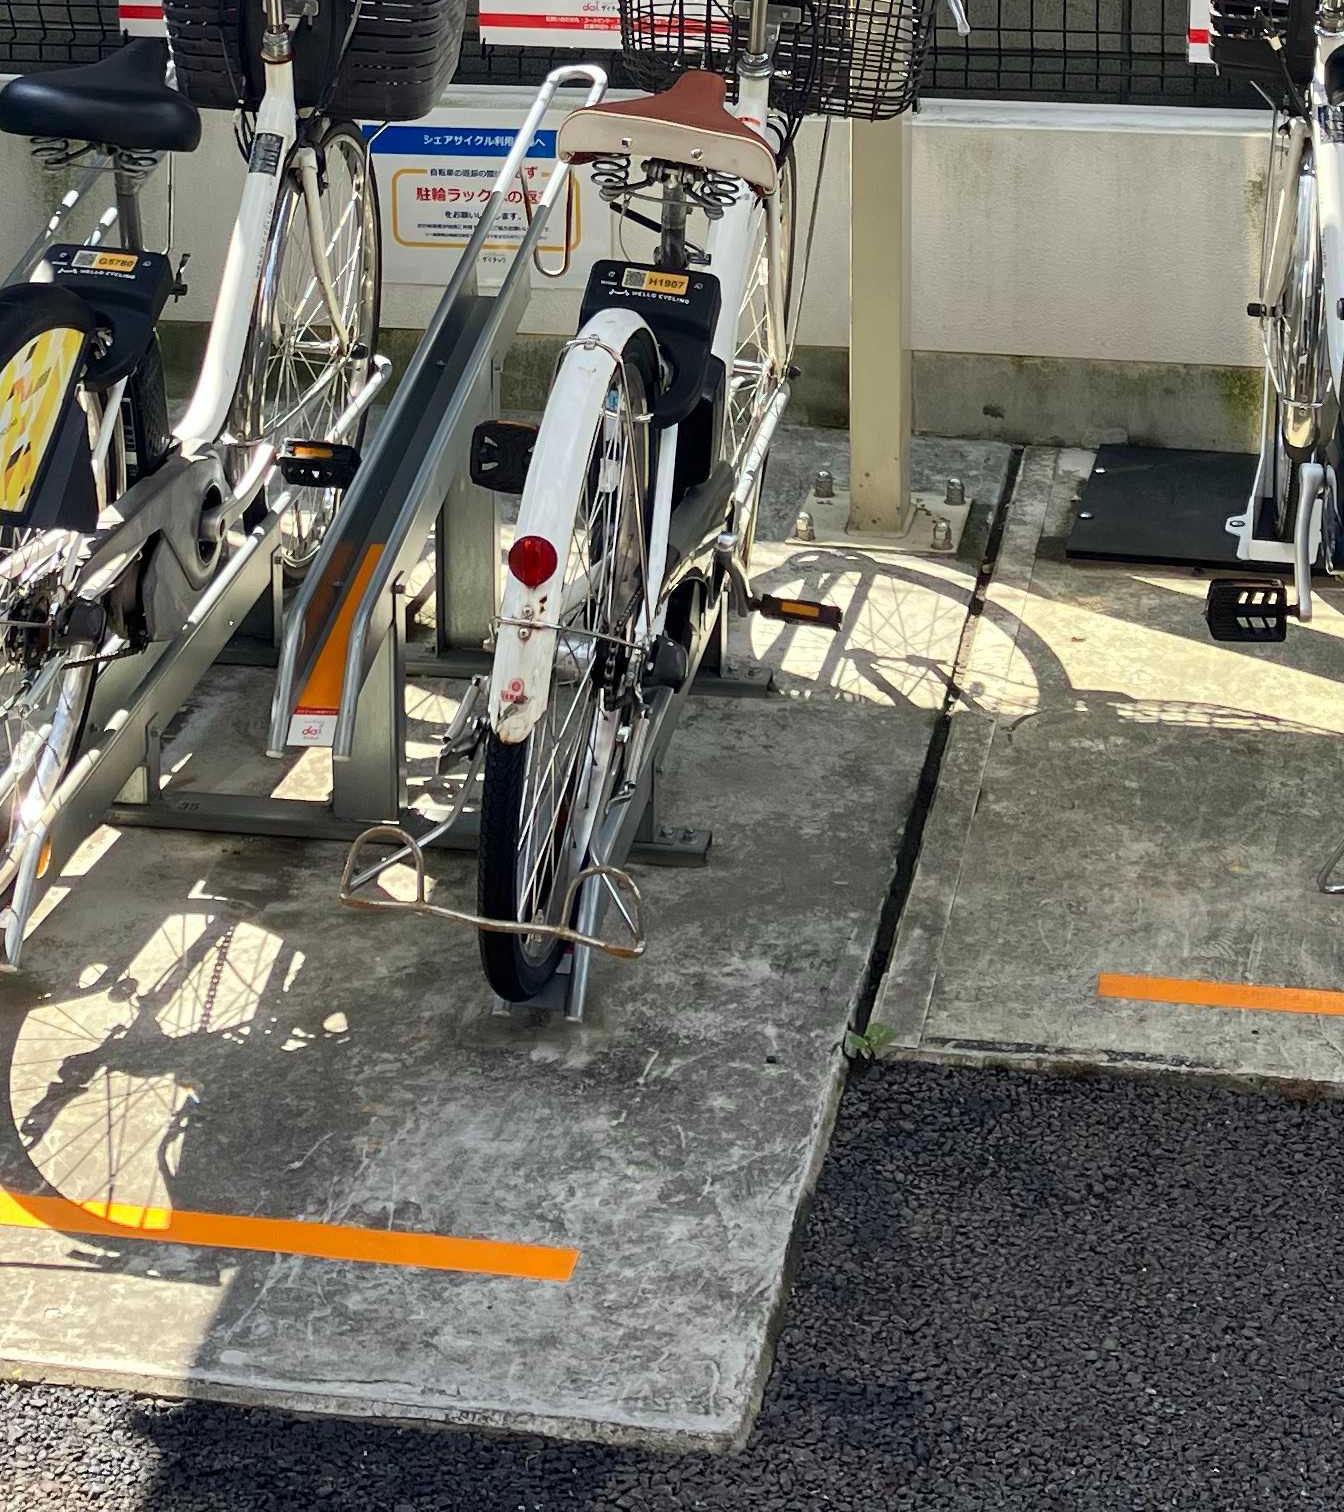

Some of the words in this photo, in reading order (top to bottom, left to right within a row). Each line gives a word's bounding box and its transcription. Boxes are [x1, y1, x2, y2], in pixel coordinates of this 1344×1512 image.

[416, 187, 544, 205] 駐輪ラックの返
